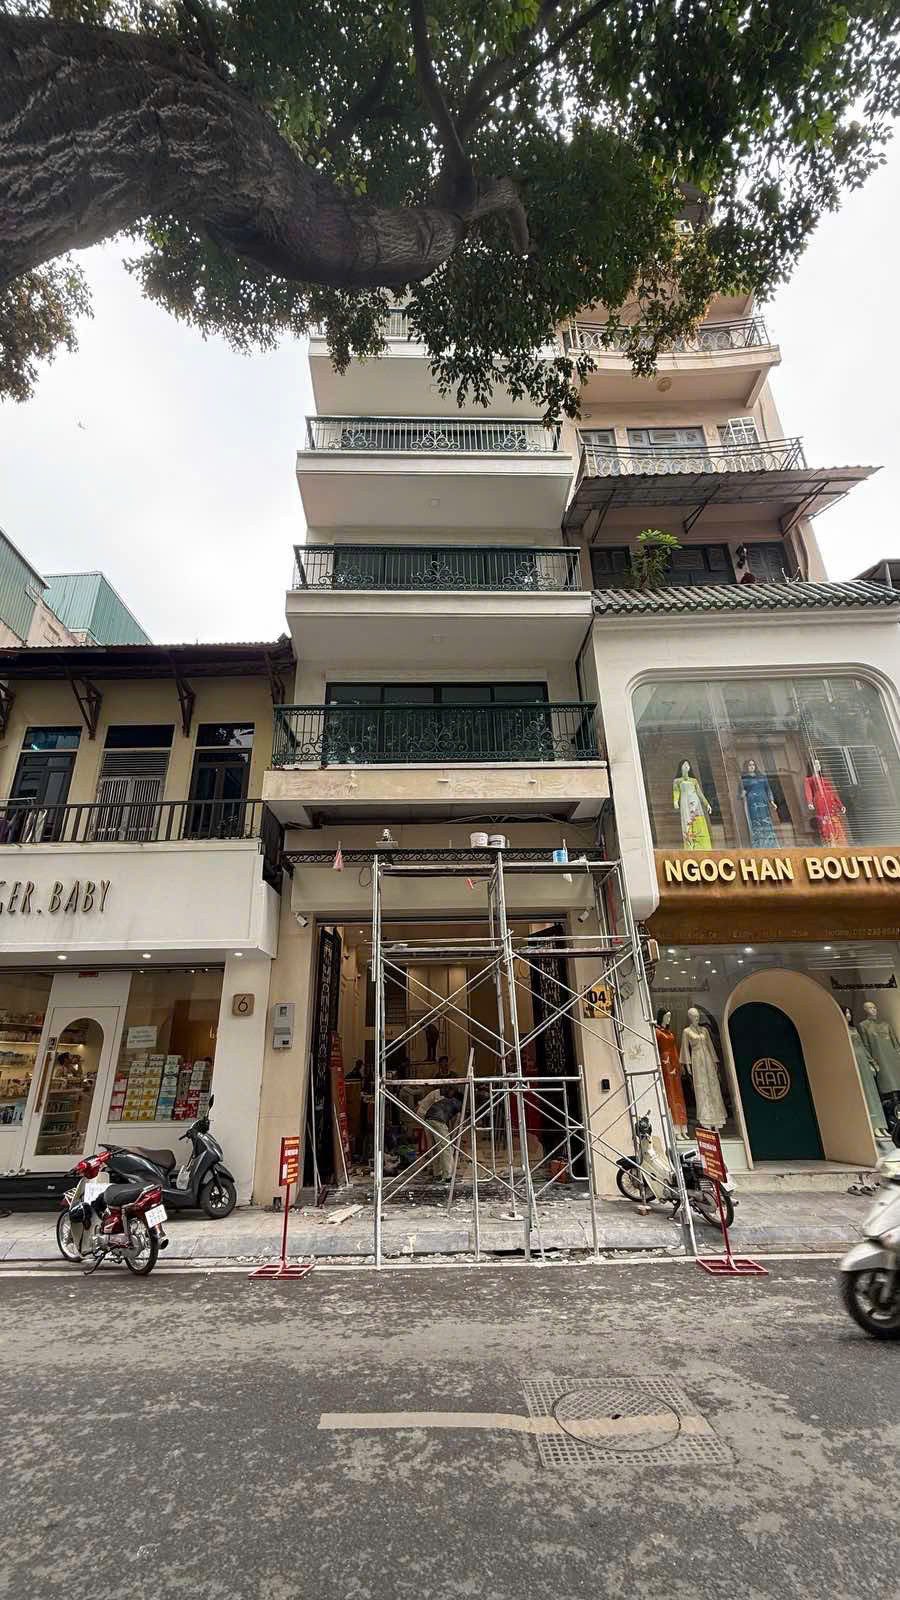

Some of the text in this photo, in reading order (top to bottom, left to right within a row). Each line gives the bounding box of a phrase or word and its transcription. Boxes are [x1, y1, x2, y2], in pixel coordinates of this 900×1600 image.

[664, 855, 900, 882] NGOC HAN BOUTIQ
[238, 996, 248, 1012] 6
[754, 1071, 787, 1085] HAN
